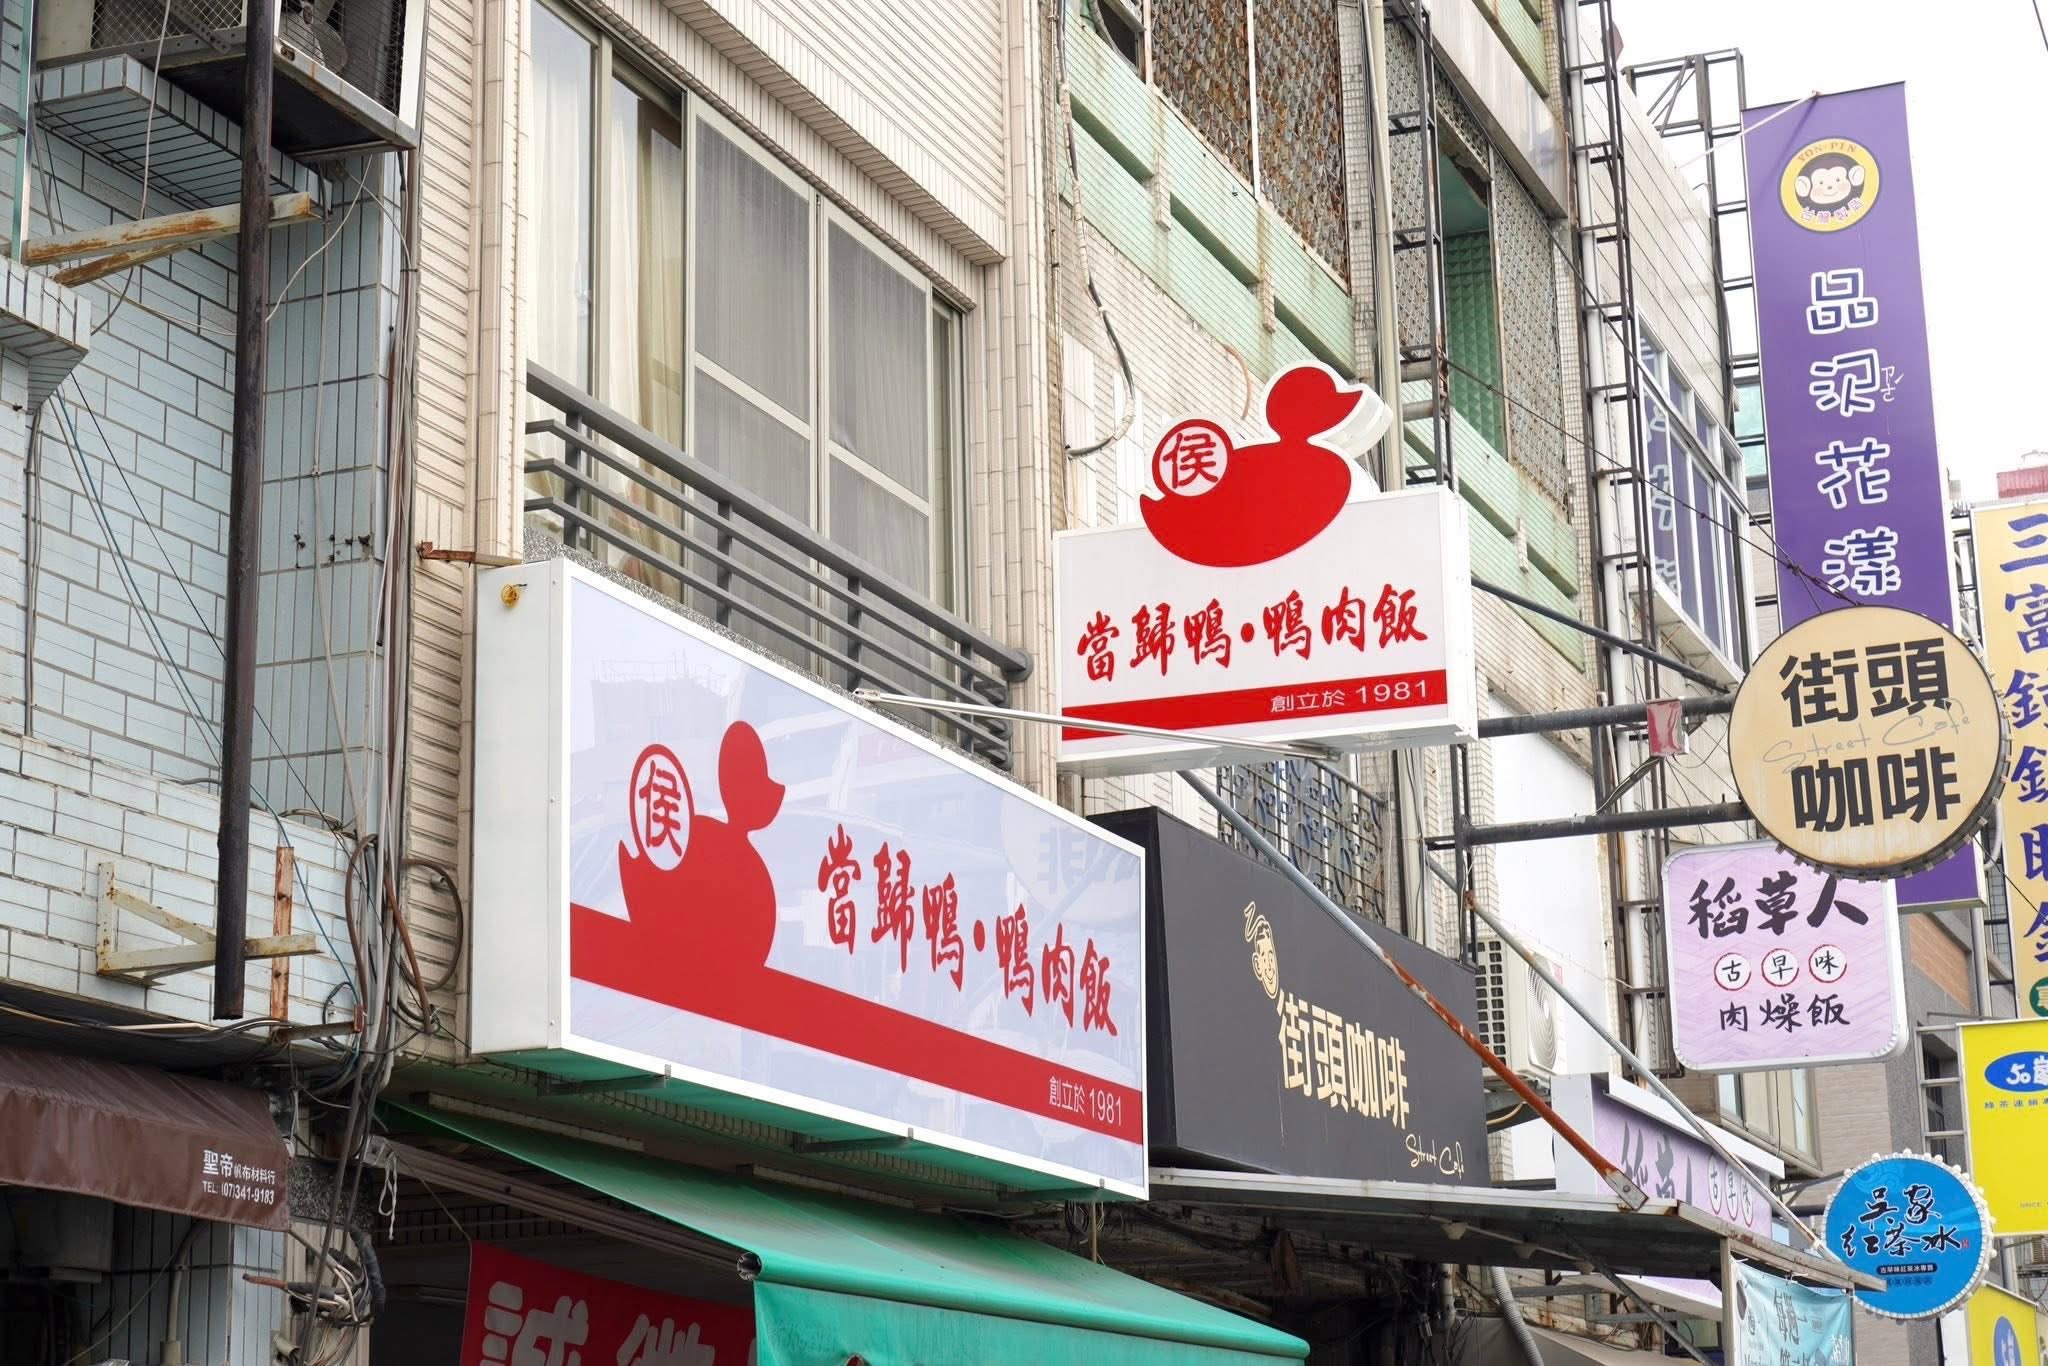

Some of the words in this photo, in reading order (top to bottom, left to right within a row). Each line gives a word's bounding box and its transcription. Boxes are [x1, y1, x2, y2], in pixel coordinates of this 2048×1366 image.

[1163, 432, 1219, 489] 侯
[1270, 689, 1346, 713] 創立於
[1355, 680, 1427, 704] 1981
[1779, 637, 1952, 728] 街頭
[1763, 723, 1871, 774] Street
[639, 759, 683, 857] 侯
[1791, 746, 1961, 833] 咖啡
[1688, 870, 1869, 939] 稻草人
[1721, 950, 1840, 982] 古早味
[1719, 993, 1851, 1033] 肉燥飯
[1276, 988, 1410, 1130] 街頭咖啡
[1049, 1076, 1086, 1115] 創立於
[1089, 1088, 1122, 1127] 1981
[221, 1182, 275, 1205] (07)341-9183
